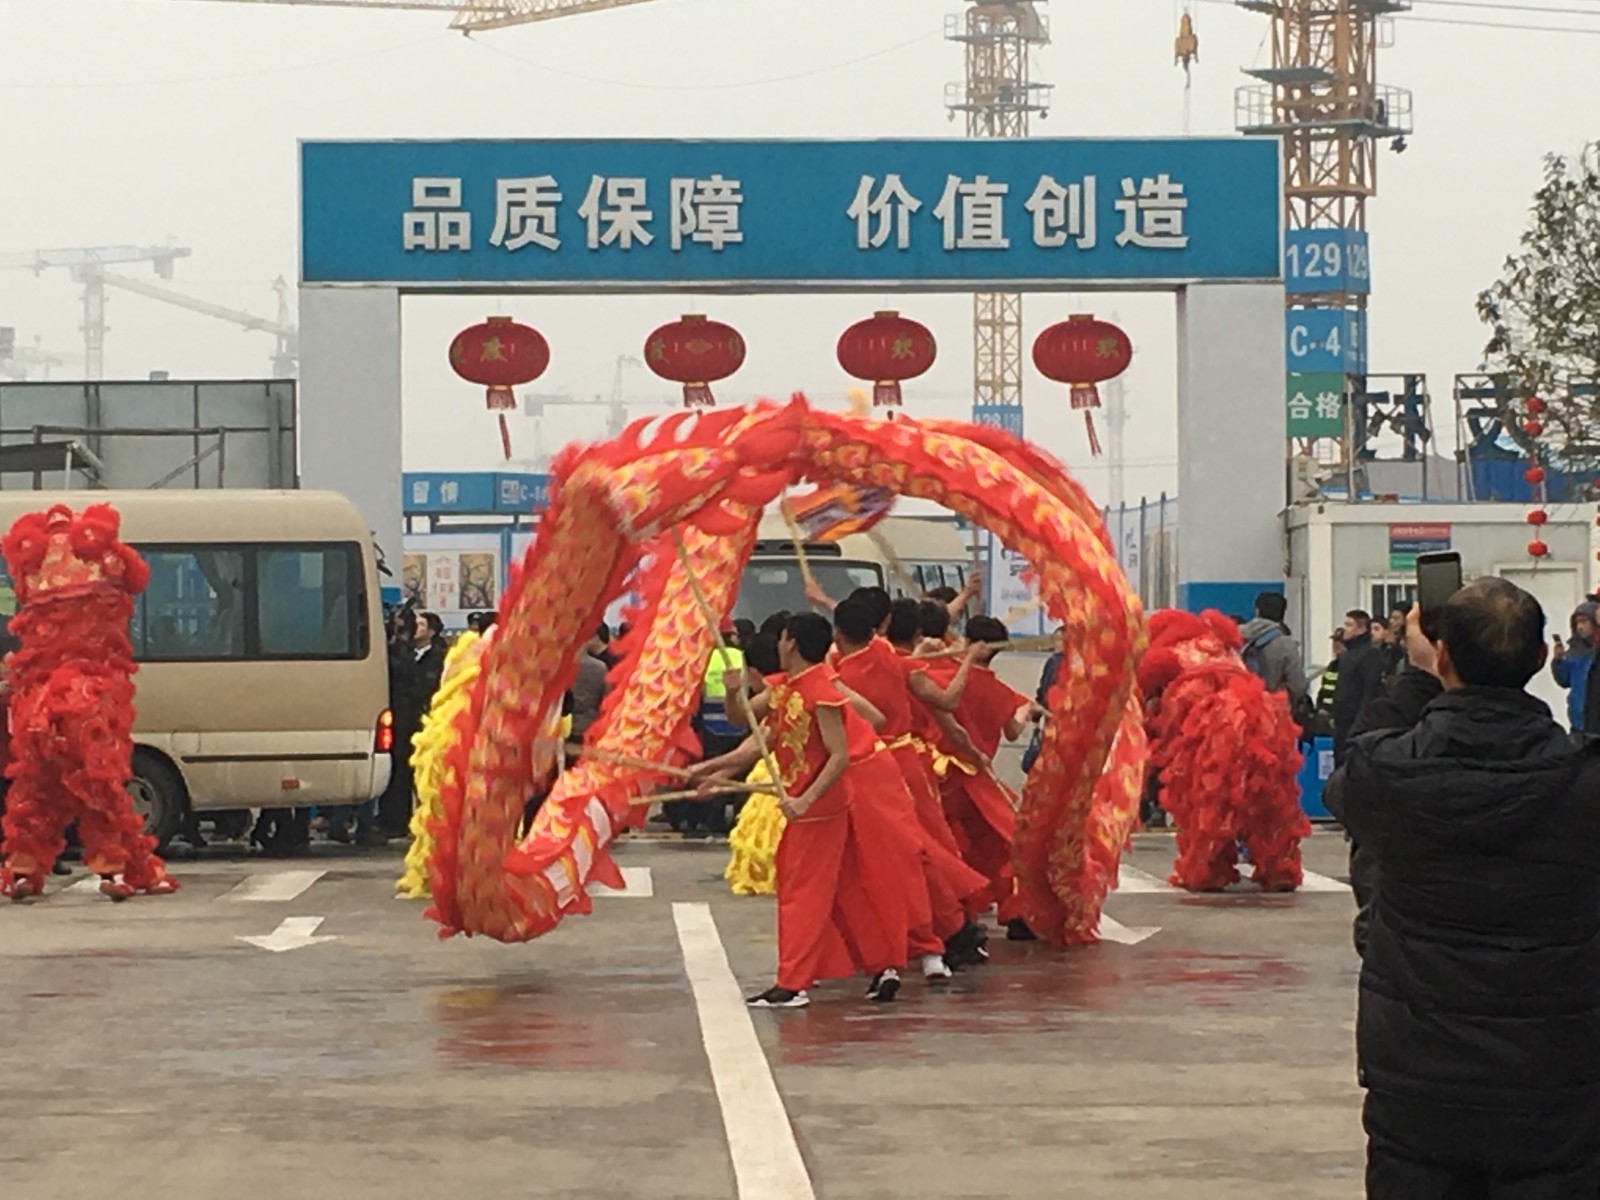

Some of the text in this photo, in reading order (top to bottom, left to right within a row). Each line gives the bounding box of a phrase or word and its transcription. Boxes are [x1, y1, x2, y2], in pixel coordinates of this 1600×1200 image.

[403, 174, 1190, 251] 品质保障 价值创造
[1286, 242, 1341, 278] 129
[1288, 392, 1341, 419] 合格
